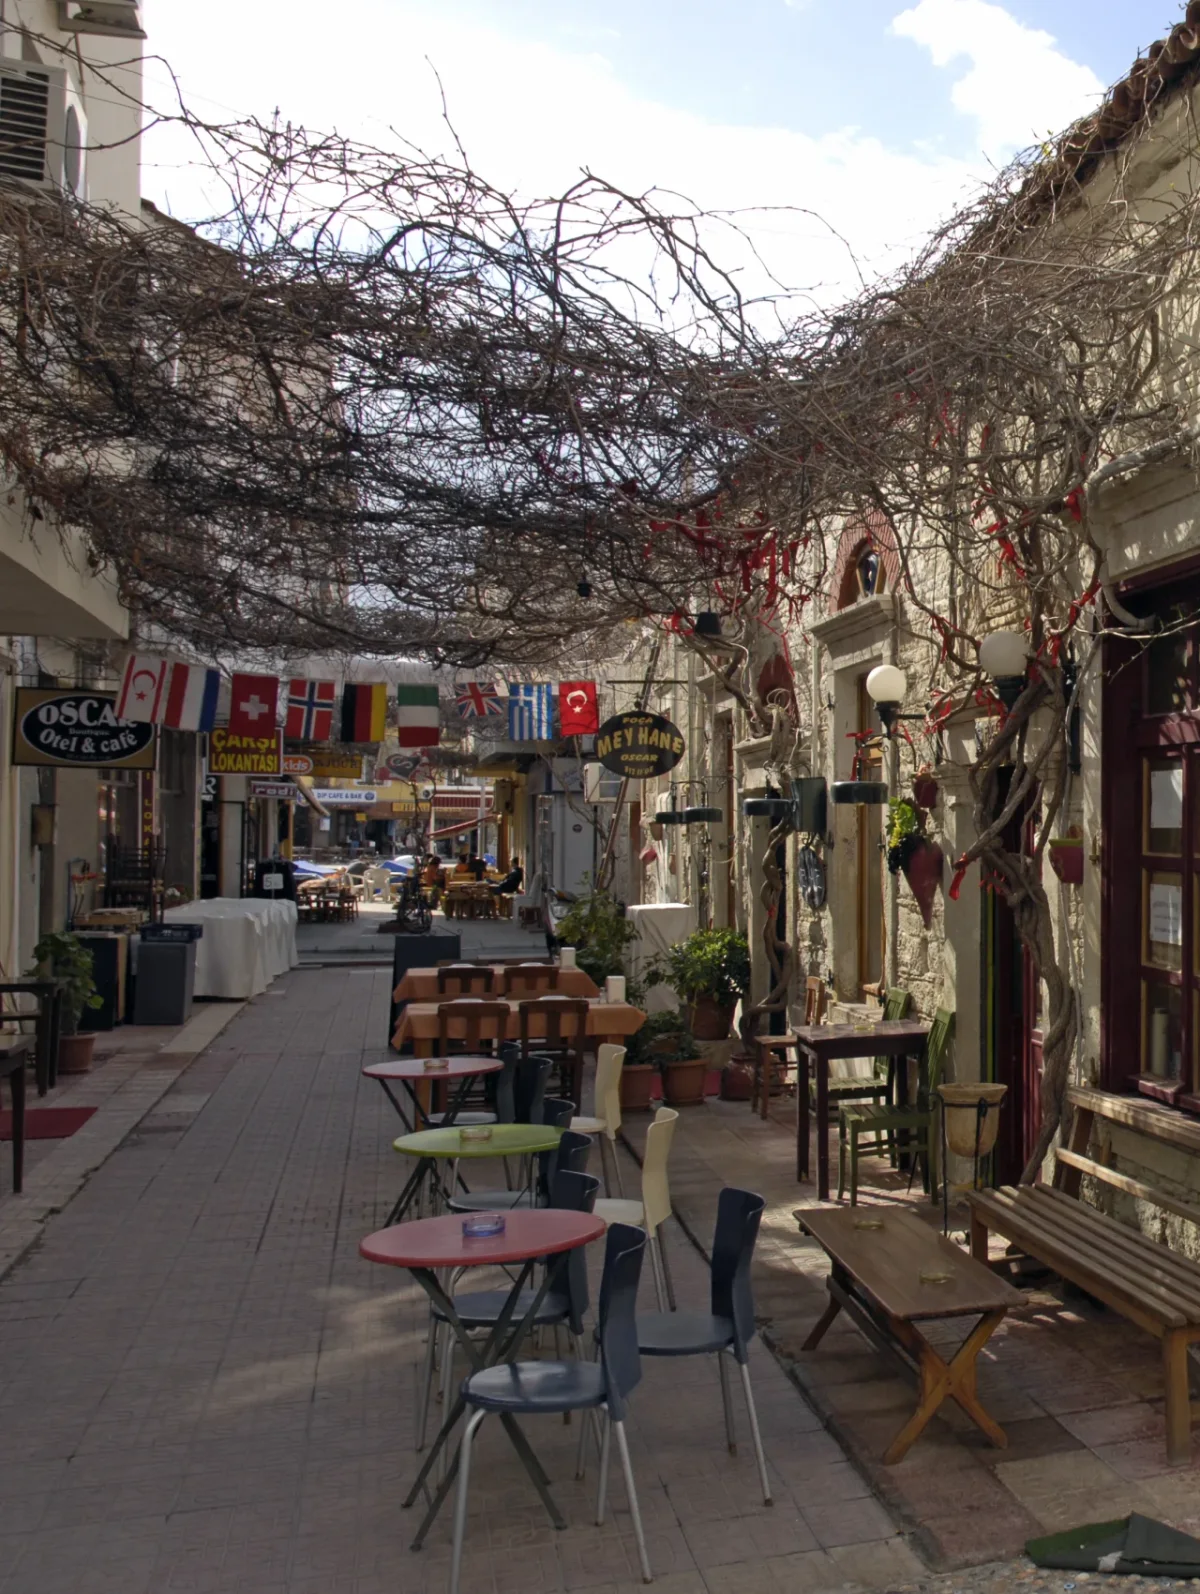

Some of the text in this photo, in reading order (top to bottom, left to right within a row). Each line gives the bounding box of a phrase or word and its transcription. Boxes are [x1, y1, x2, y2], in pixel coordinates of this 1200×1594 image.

[38, 700, 137, 728] OSCA
[40, 728, 138, 753] Otel & café
[211, 752, 278, 772] LOKANTASI
[620, 753, 658, 762] OSCAR
